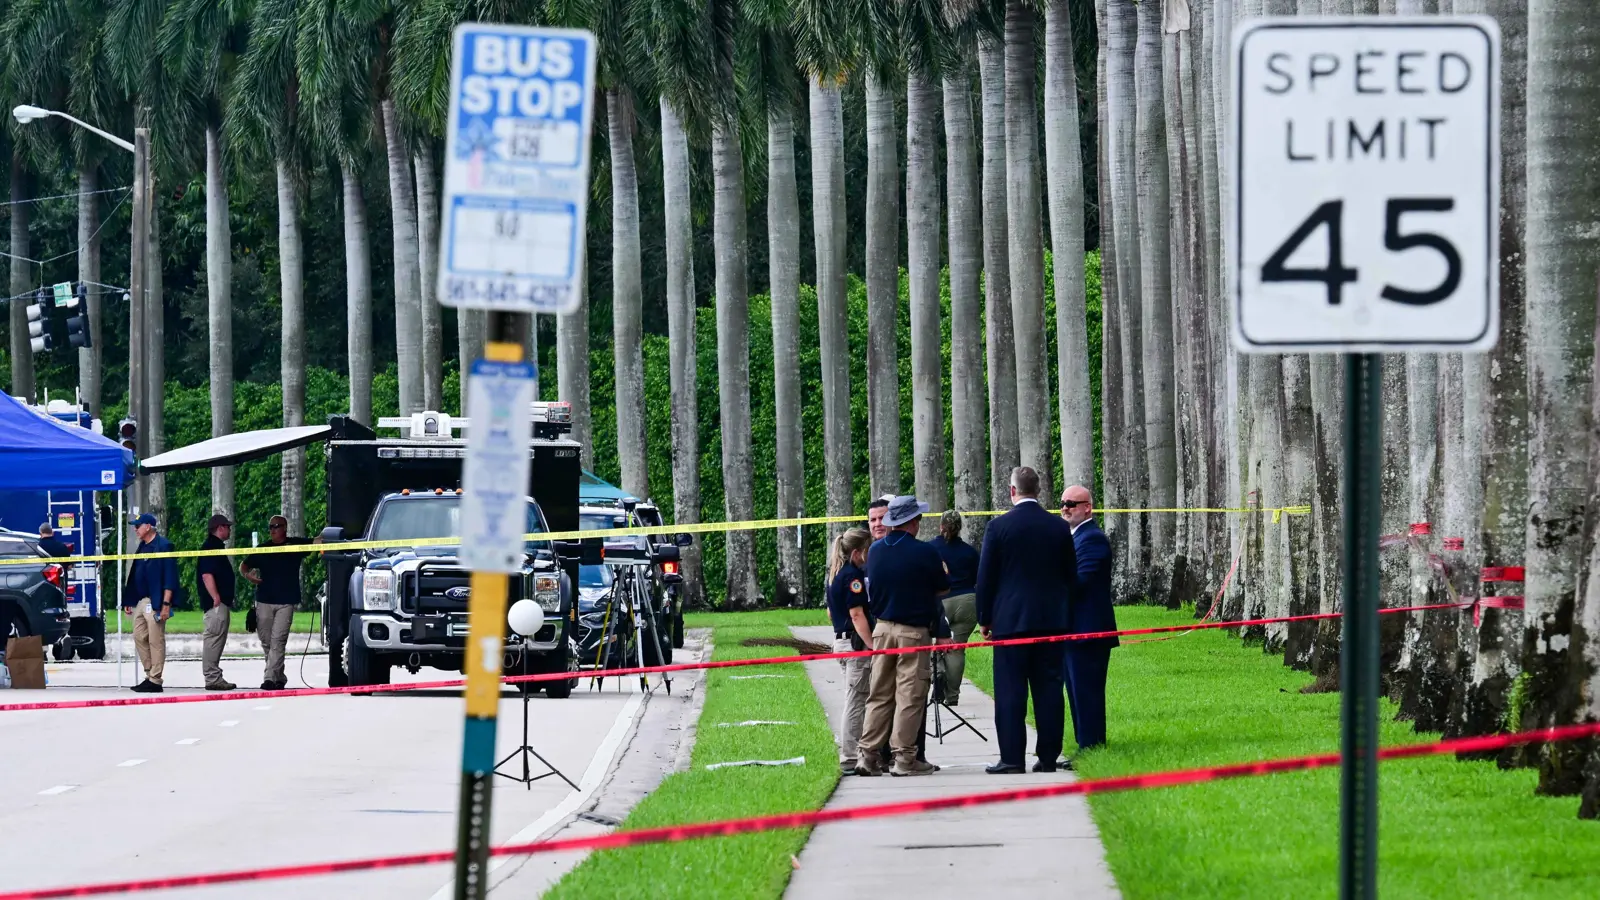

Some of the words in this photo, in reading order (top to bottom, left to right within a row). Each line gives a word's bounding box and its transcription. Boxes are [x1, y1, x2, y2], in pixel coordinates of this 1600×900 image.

[473, 34, 574, 78] BUS
[1264, 51, 1473, 94] SPEED
[461, 75, 581, 118] STOP
[1286, 117, 1448, 162] LIMIT
[1260, 197, 1463, 306] 45
